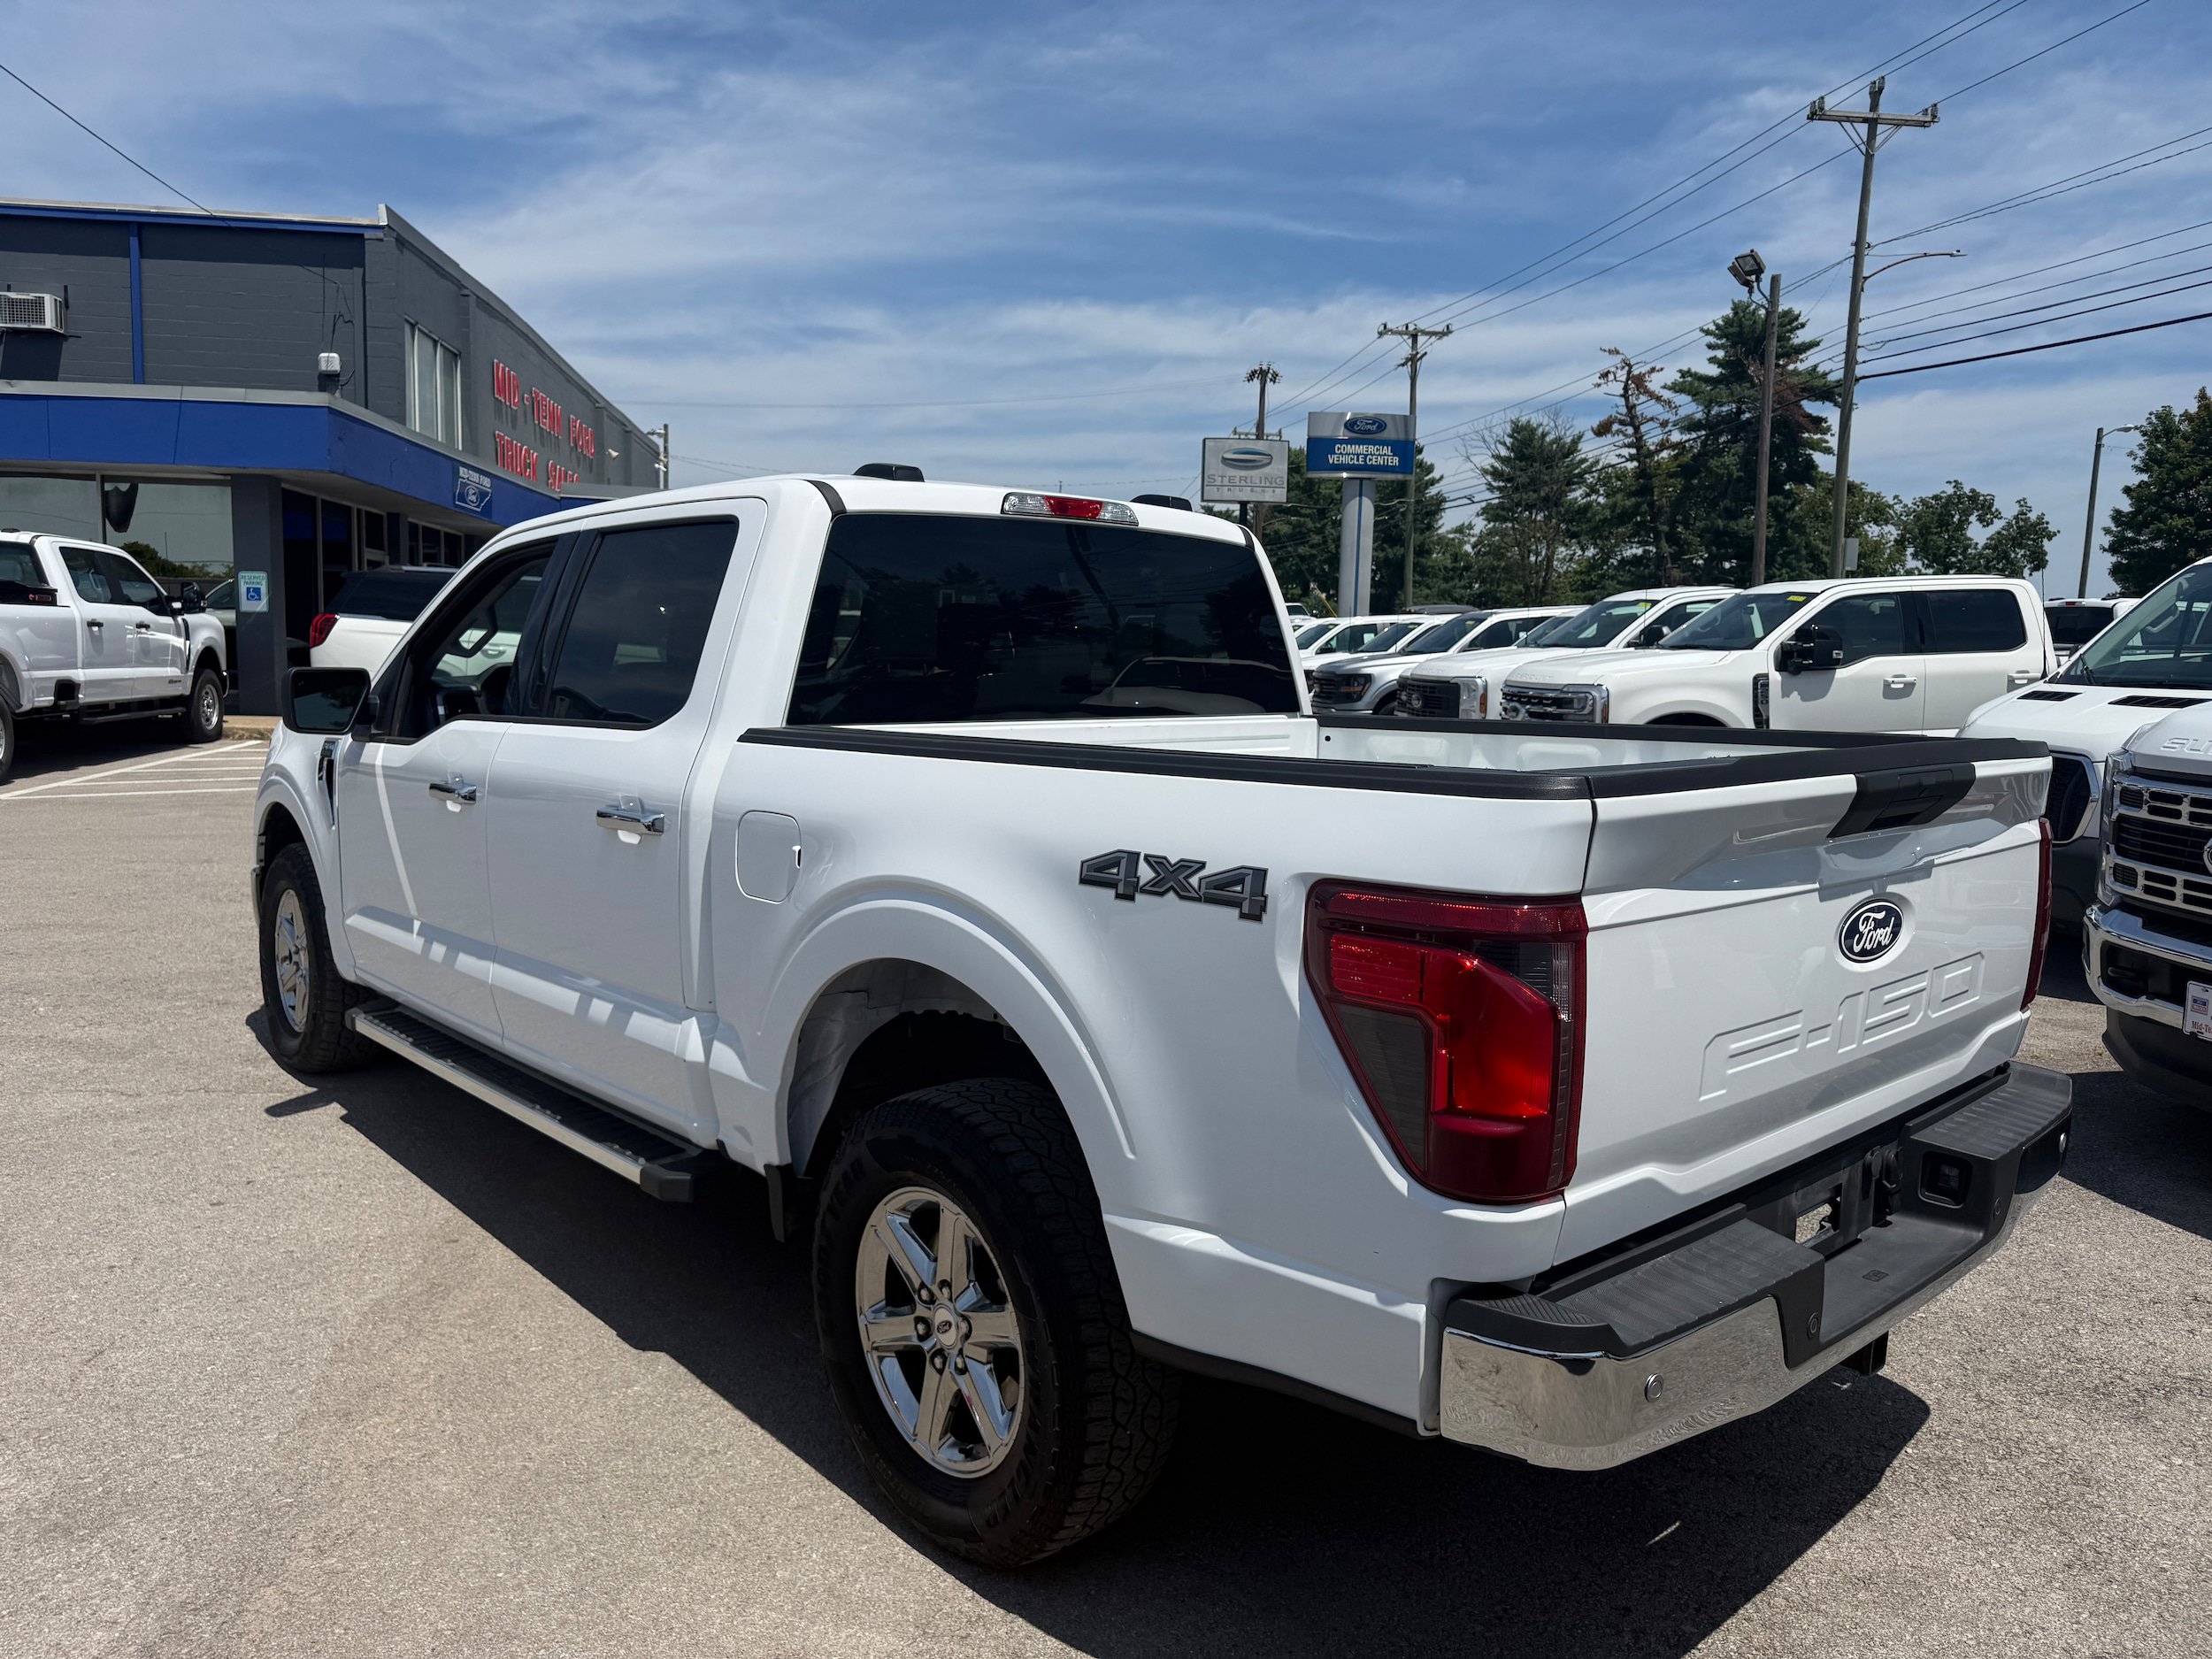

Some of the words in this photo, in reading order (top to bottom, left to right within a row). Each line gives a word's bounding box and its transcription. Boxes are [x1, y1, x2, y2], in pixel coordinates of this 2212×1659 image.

[1354, 419, 1379, 431] Ford
[570, 414, 595, 458] FORD
[495, 430, 538, 482] TRUCK
[1334, 443, 1394, 456] COMMERCIAL
[1328, 454, 1364, 465] VEHICLE
[1366, 455, 1399, 466] CENTER
[1206, 473, 1285, 486] STERLING
[2160, 736, 2212, 755] SU
[1854, 910, 1894, 953] Ford
[1699, 952, 1985, 1101] F-150
